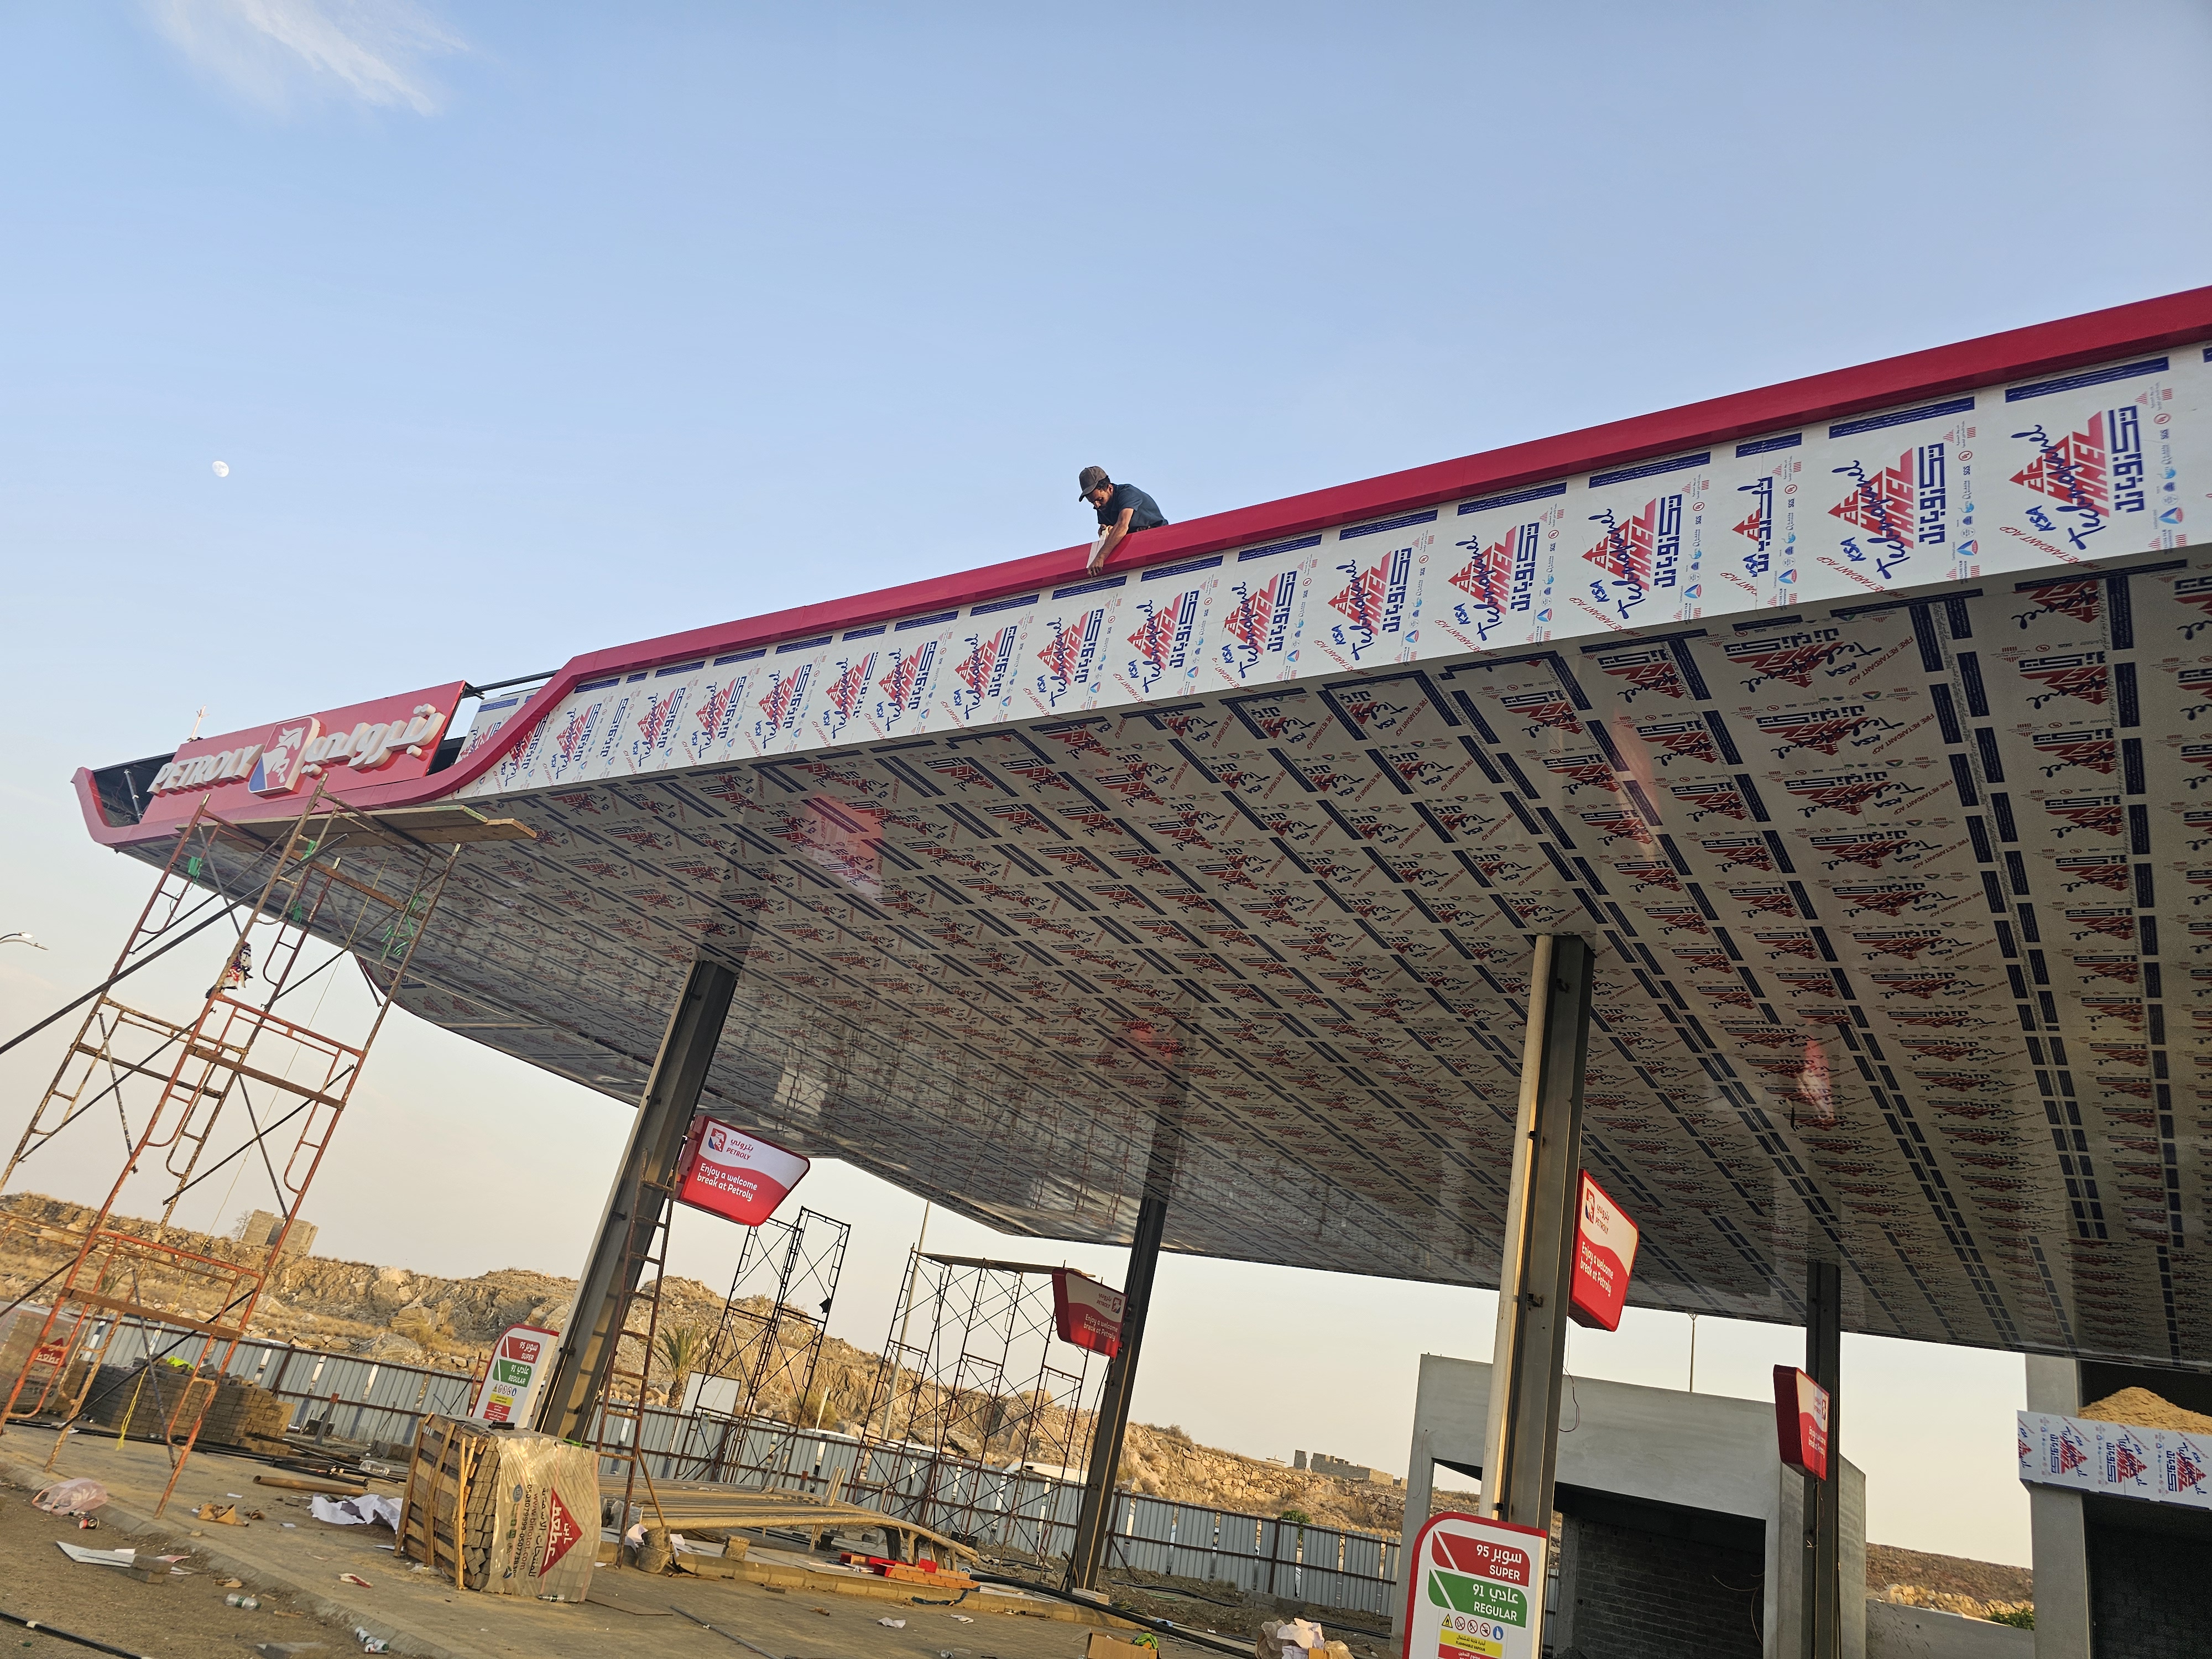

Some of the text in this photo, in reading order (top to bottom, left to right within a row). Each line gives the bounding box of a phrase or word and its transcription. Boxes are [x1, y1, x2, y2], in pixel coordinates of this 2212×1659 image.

[2026, 505, 2056, 531] KSA
[2000, 527, 2027, 536] ACP
[1840, 537, 1866, 561] KSA
[1817, 557, 1840, 566] ACP
[1590, 580, 1610, 602] KSA
[1569, 597, 1588, 606] ACP
[1453, 603, 1470, 624] KSA
[1331, 624, 1346, 645] KSA
[1222, 644, 1234, 663] KSA
[1128, 659, 1139, 678] KSA
[1037, 675, 1046, 692] KSA
[301, 703, 446, 775] بترولي
[147, 744, 265, 795] PETROLY
[727, 1147, 751, 1160] PETROLY
[731, 1139, 753, 1152] بترولي
[700, 1163, 720, 1179] Enjoy
[727, 1176, 758, 1190] welcome
[697, 1172, 718, 1187] break
[727, 1184, 753, 1201] Petroly
[1595, 1217, 1608, 1234] PETROLY
[1582, 1241, 1614, 1280] Enjoy a welcome
[1580, 1256, 1611, 1297] break at Petroly
[1084, 1322, 1095, 1332] break
[1101, 1329, 1115, 1342] Petroly
[1086, 1314, 1097, 1325] Enjoy
[1100, 1322, 1118, 1332] welcome
[524, 1343, 538, 1352] سوبر
[517, 1366, 529, 1374] عادي
[508, 1375, 525, 1385] REGULAR
[519, 1493, 538, 1570] www.binotot.com
[563, 1523, 573, 1544] ابن
[1477, 1545, 1522, 1564] سوبر 95
[1489, 1565, 1520, 1580] SUPER
[1473, 1584, 1519, 1604] عادي 91
[1474, 1601, 1517, 1621] REGULAR
[1455, 1641, 1473, 1649] FLAMMABLE
